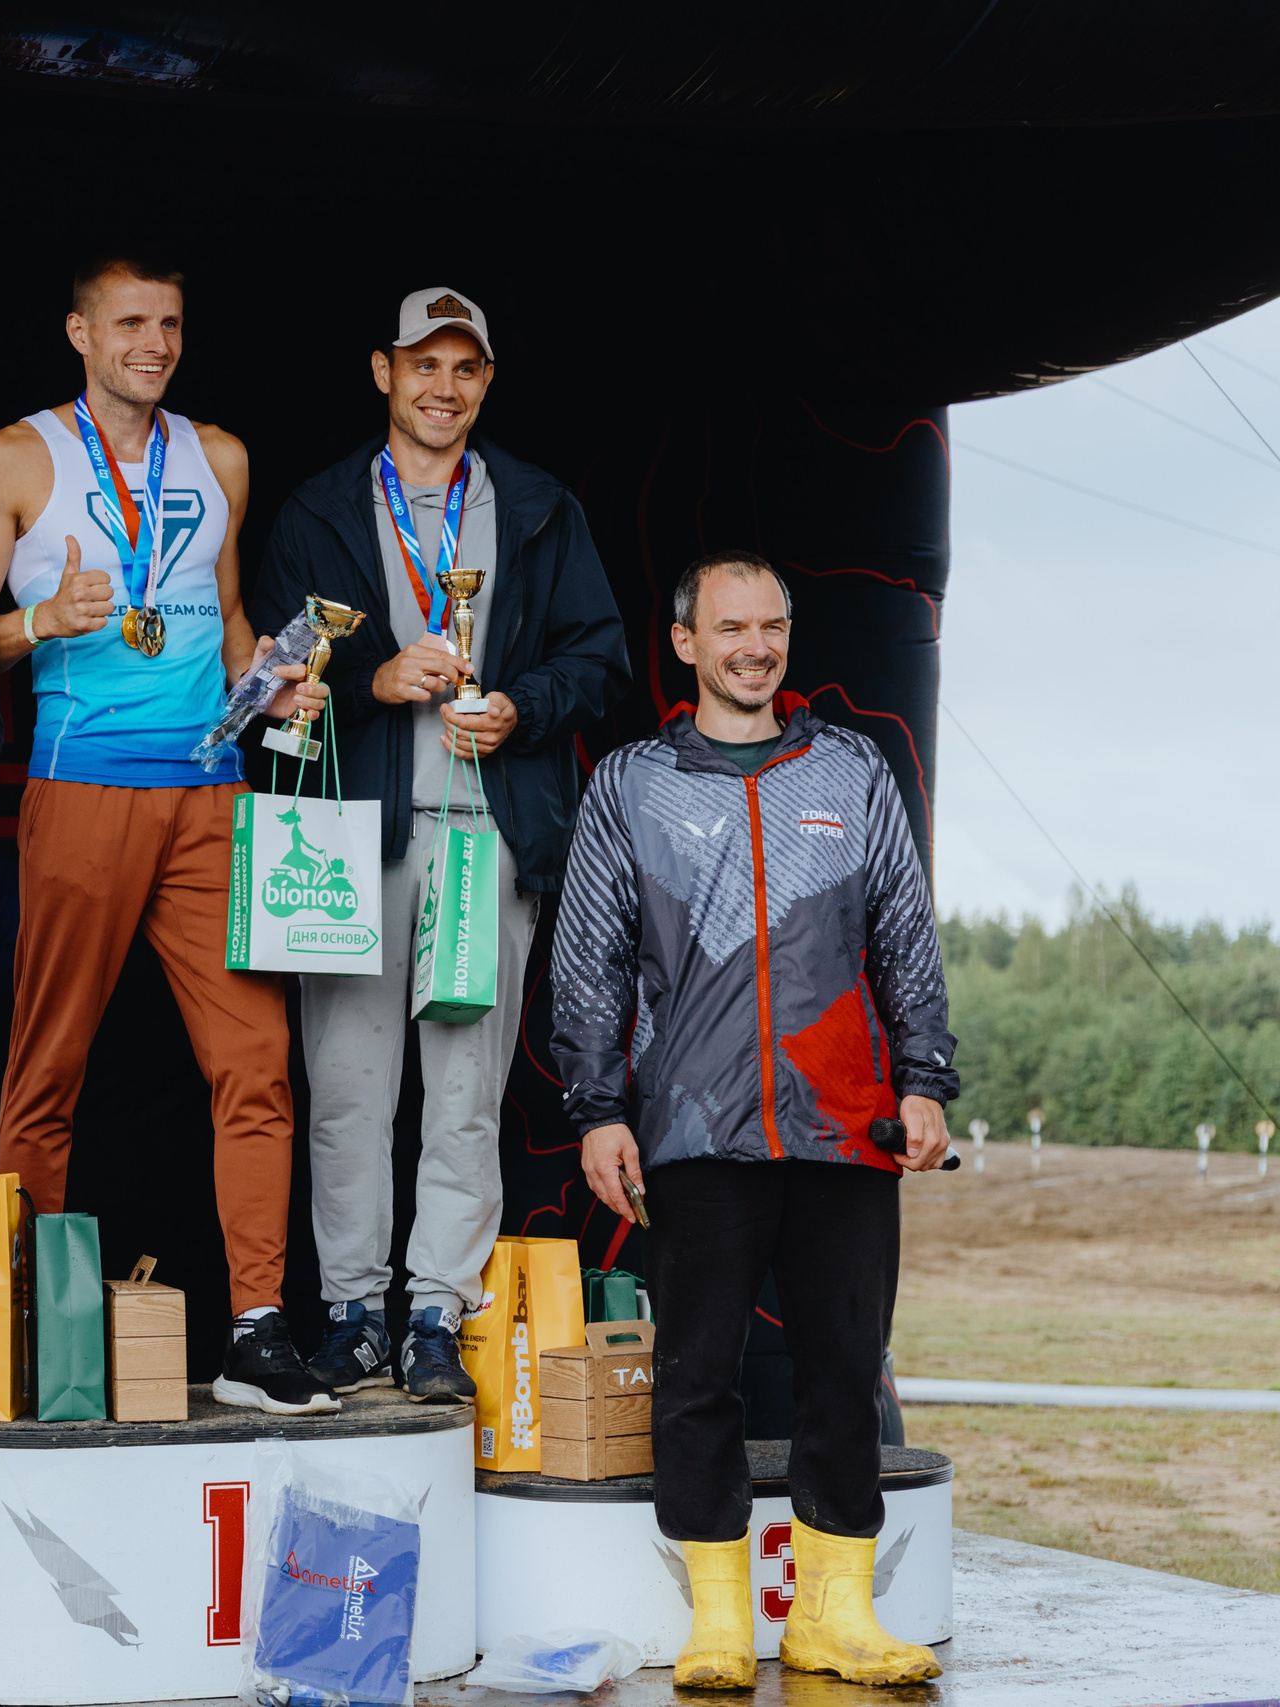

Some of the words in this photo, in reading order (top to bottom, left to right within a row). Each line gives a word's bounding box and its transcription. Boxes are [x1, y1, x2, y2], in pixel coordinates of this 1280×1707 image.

[87, 435, 105, 468] СПОРТ
[152, 446, 164, 478] СПОРТ
[389, 486, 405, 516] СПОРТ
[155, 604, 195, 616] TEAM
[198, 605, 219, 617] OCR
[800, 824, 844, 839] ГЕРОЕВ
[801, 810, 842, 824] ГОНКА
[239, 844, 249, 963] PUBLIC_BIONOVA
[265, 879, 357, 909] bionova
[454, 836, 474, 999] BIONOVA-SHOP.RU
[291, 931, 318, 945] ДНЯ
[320, 932, 370, 945] ОСНОВА
[470, 1334, 488, 1343] ENERGY
[510, 1266, 534, 1450] #Bombbar
[612, 1367, 653, 1386] TA
[203, 1481, 250, 1647] 1
[301, 1569, 376, 1593] ametist
